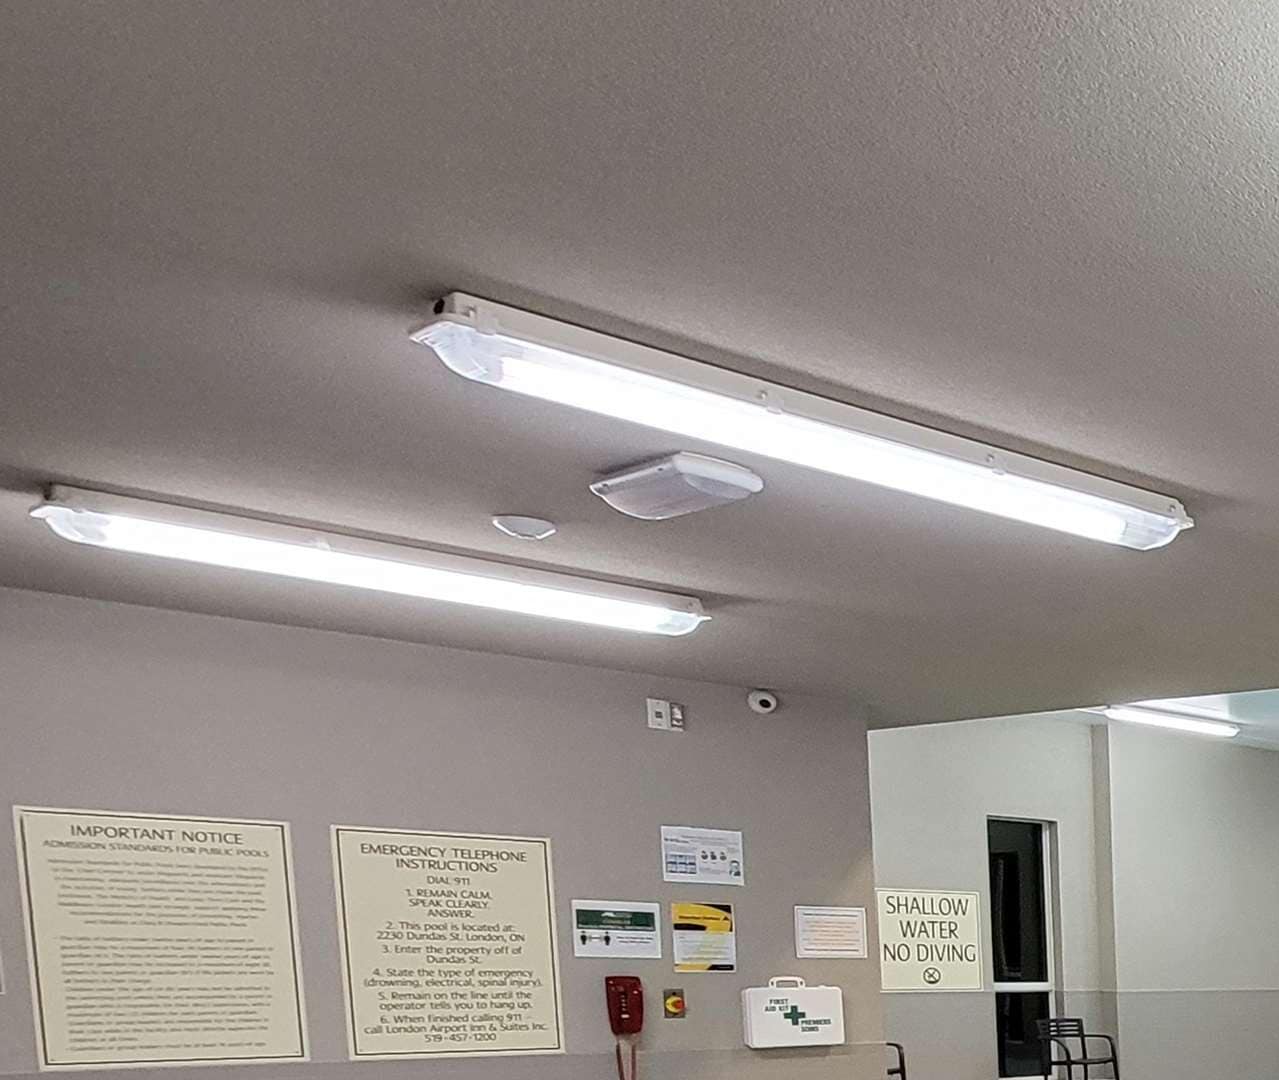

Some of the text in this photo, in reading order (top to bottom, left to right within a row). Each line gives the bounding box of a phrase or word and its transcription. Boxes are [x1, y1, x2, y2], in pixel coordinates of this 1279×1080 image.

[70, 824, 244, 845] IMPORTANT NOTICE
[108, 842, 174, 853] STANDARDS
[176, 846, 196, 854] FOR
[199, 847, 233, 856] PUBLIC
[236, 849, 270, 858] POOLS
[360, 843, 528, 862] EMERGENCY TELEPHONE
[395, 858, 498, 873] INSTRUCTIONS
[427, 875, 470, 885] DIAL 911
[417, 889, 457, 898] REMAIN
[408, 899, 442, 908] SPEAK
[886, 895, 969, 916] SHALLOW
[399, 921, 421, 930] This
[424, 922, 447, 931] pool
[451, 923, 459, 931] is
[462, 923, 500, 932] located
[899, 920, 959, 939] WATER
[376, 931, 404, 940] 2230
[407, 931, 447, 940] Dundas
[466, 933, 507, 942] London,
[395, 945, 421, 954] Enter
[426, 945, 443, 954] the
[446, 946, 491, 955] property
[494, 946, 508, 954] off
[511, 946, 522, 954] of
[883, 943, 976, 962] NO DIVING
[427, 955, 467, 963] Dundas
[386, 968, 414, 977] State
[417, 968, 435, 977] the
[438, 968, 461, 978] type
[464, 968, 474, 977] of
[478, 970, 533, 980] emergency
[478, 979, 507, 988] spinal
[391, 991, 431, 1000] Remain
[451, 992, 467, 1000] the
[471, 991, 488, 999] line
[491, 991, 513, 999] until
[516, 991, 532, 999] the
[380, 1003, 425, 1011] operator
[490, 1001, 515, 1010] hang
[393, 1015, 425, 1023] When
[428, 1014, 469, 1022] finished
[471, 1013, 504, 1023] calling
[507, 1013, 522, 1021] 911
[364, 1026, 383, 1034] call
[386, 1025, 427, 1034] London
[430, 1025, 467, 1033] Airport
[470, 1024, 487, 1032] Inn
[500, 1023, 530, 1031] Suites
